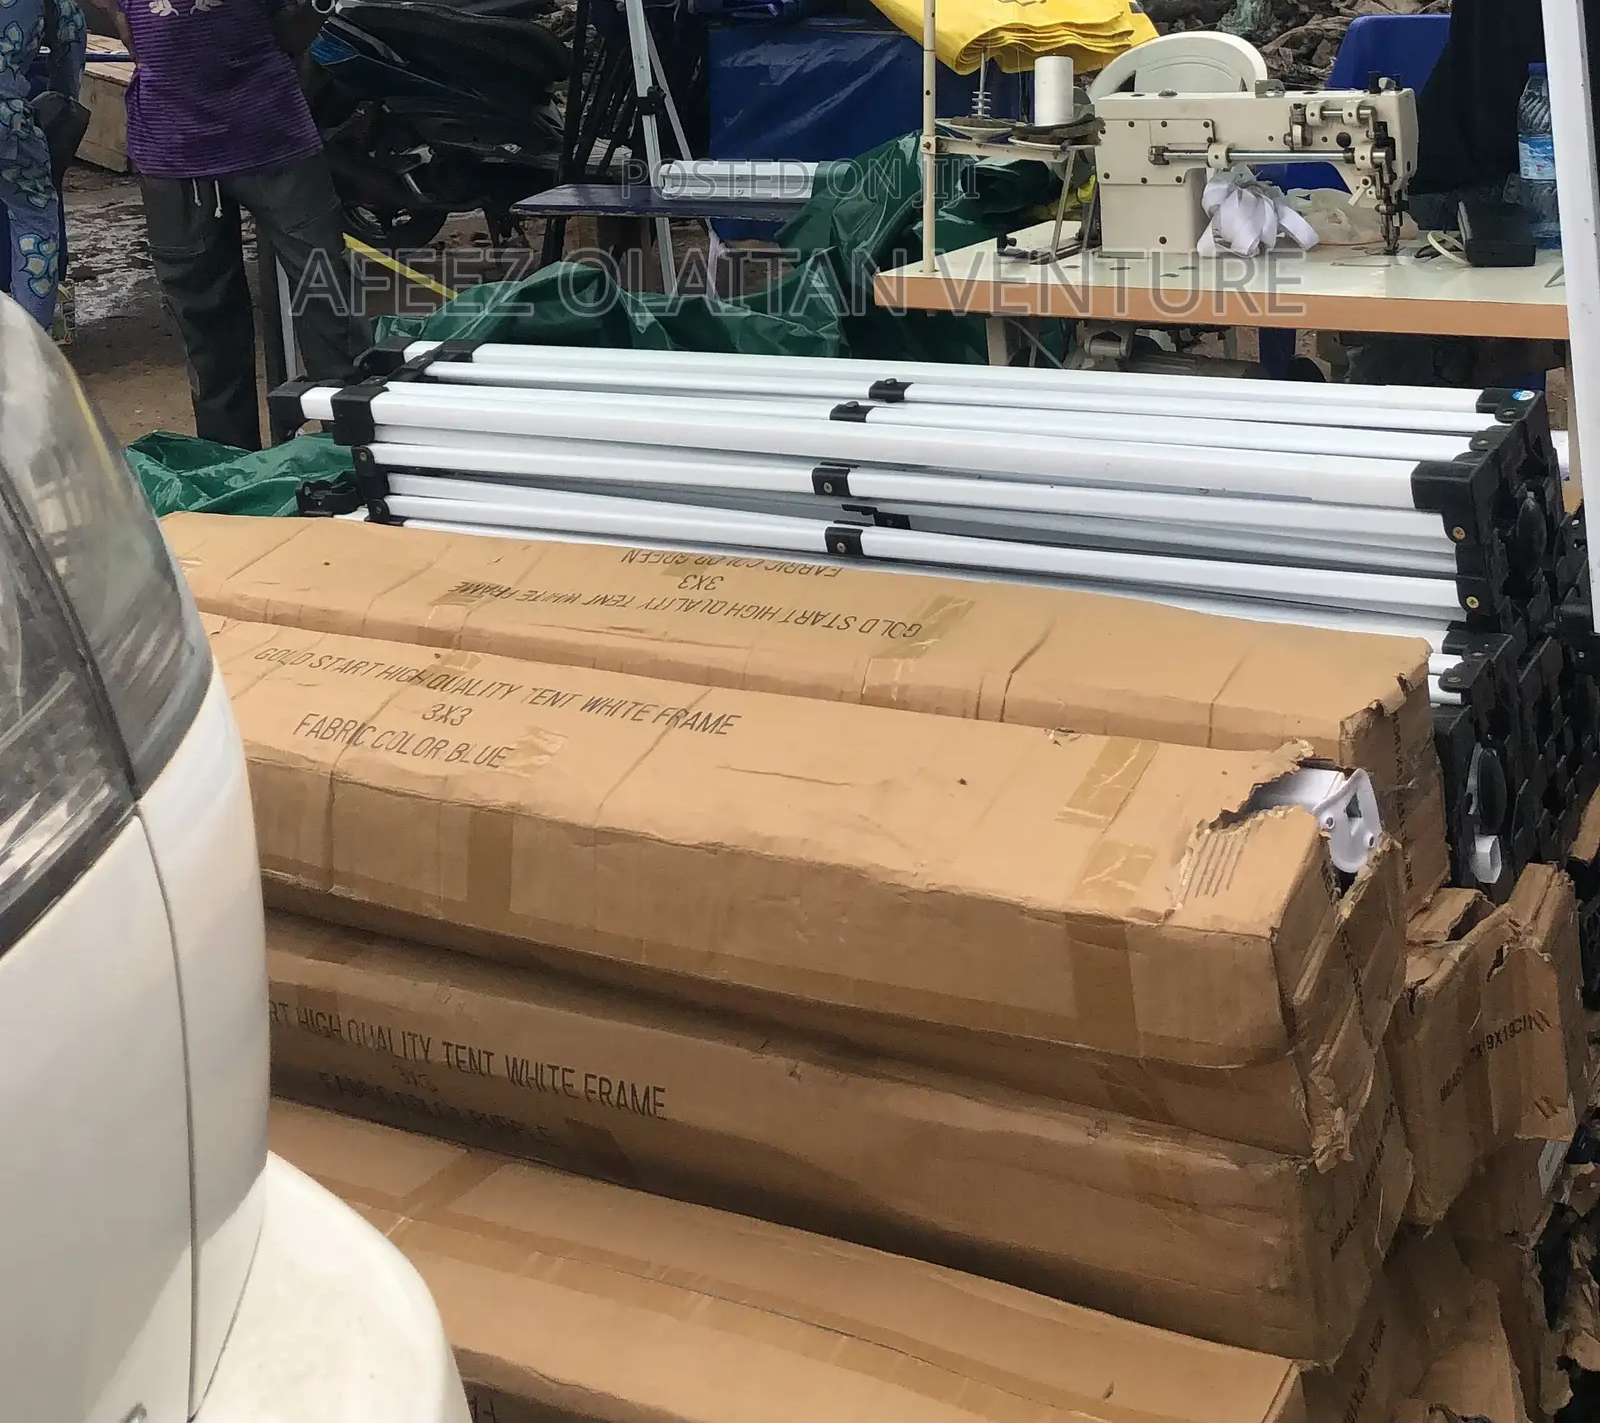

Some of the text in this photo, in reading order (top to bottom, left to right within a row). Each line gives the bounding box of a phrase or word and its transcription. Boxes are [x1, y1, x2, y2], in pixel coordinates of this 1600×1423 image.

[677, 574, 724, 591] 3X3
[448, 581, 923, 639] GOLD START HIGH QUALITY TENT WHITE FRAME
[253, 647, 742, 735] GOLD START HIGH QUALITY TENT WHITE FRAME
[292, 712, 377, 746] FABRIC
[421, 703, 473, 727] 3X3
[296, 1006, 344, 1041] HIGH
[348, 1018, 432, 1063] QUALITY
[441, 1040, 494, 1077] TENT
[505, 1054, 579, 1099] WHITE
[584, 1072, 667, 1121] FRAME
